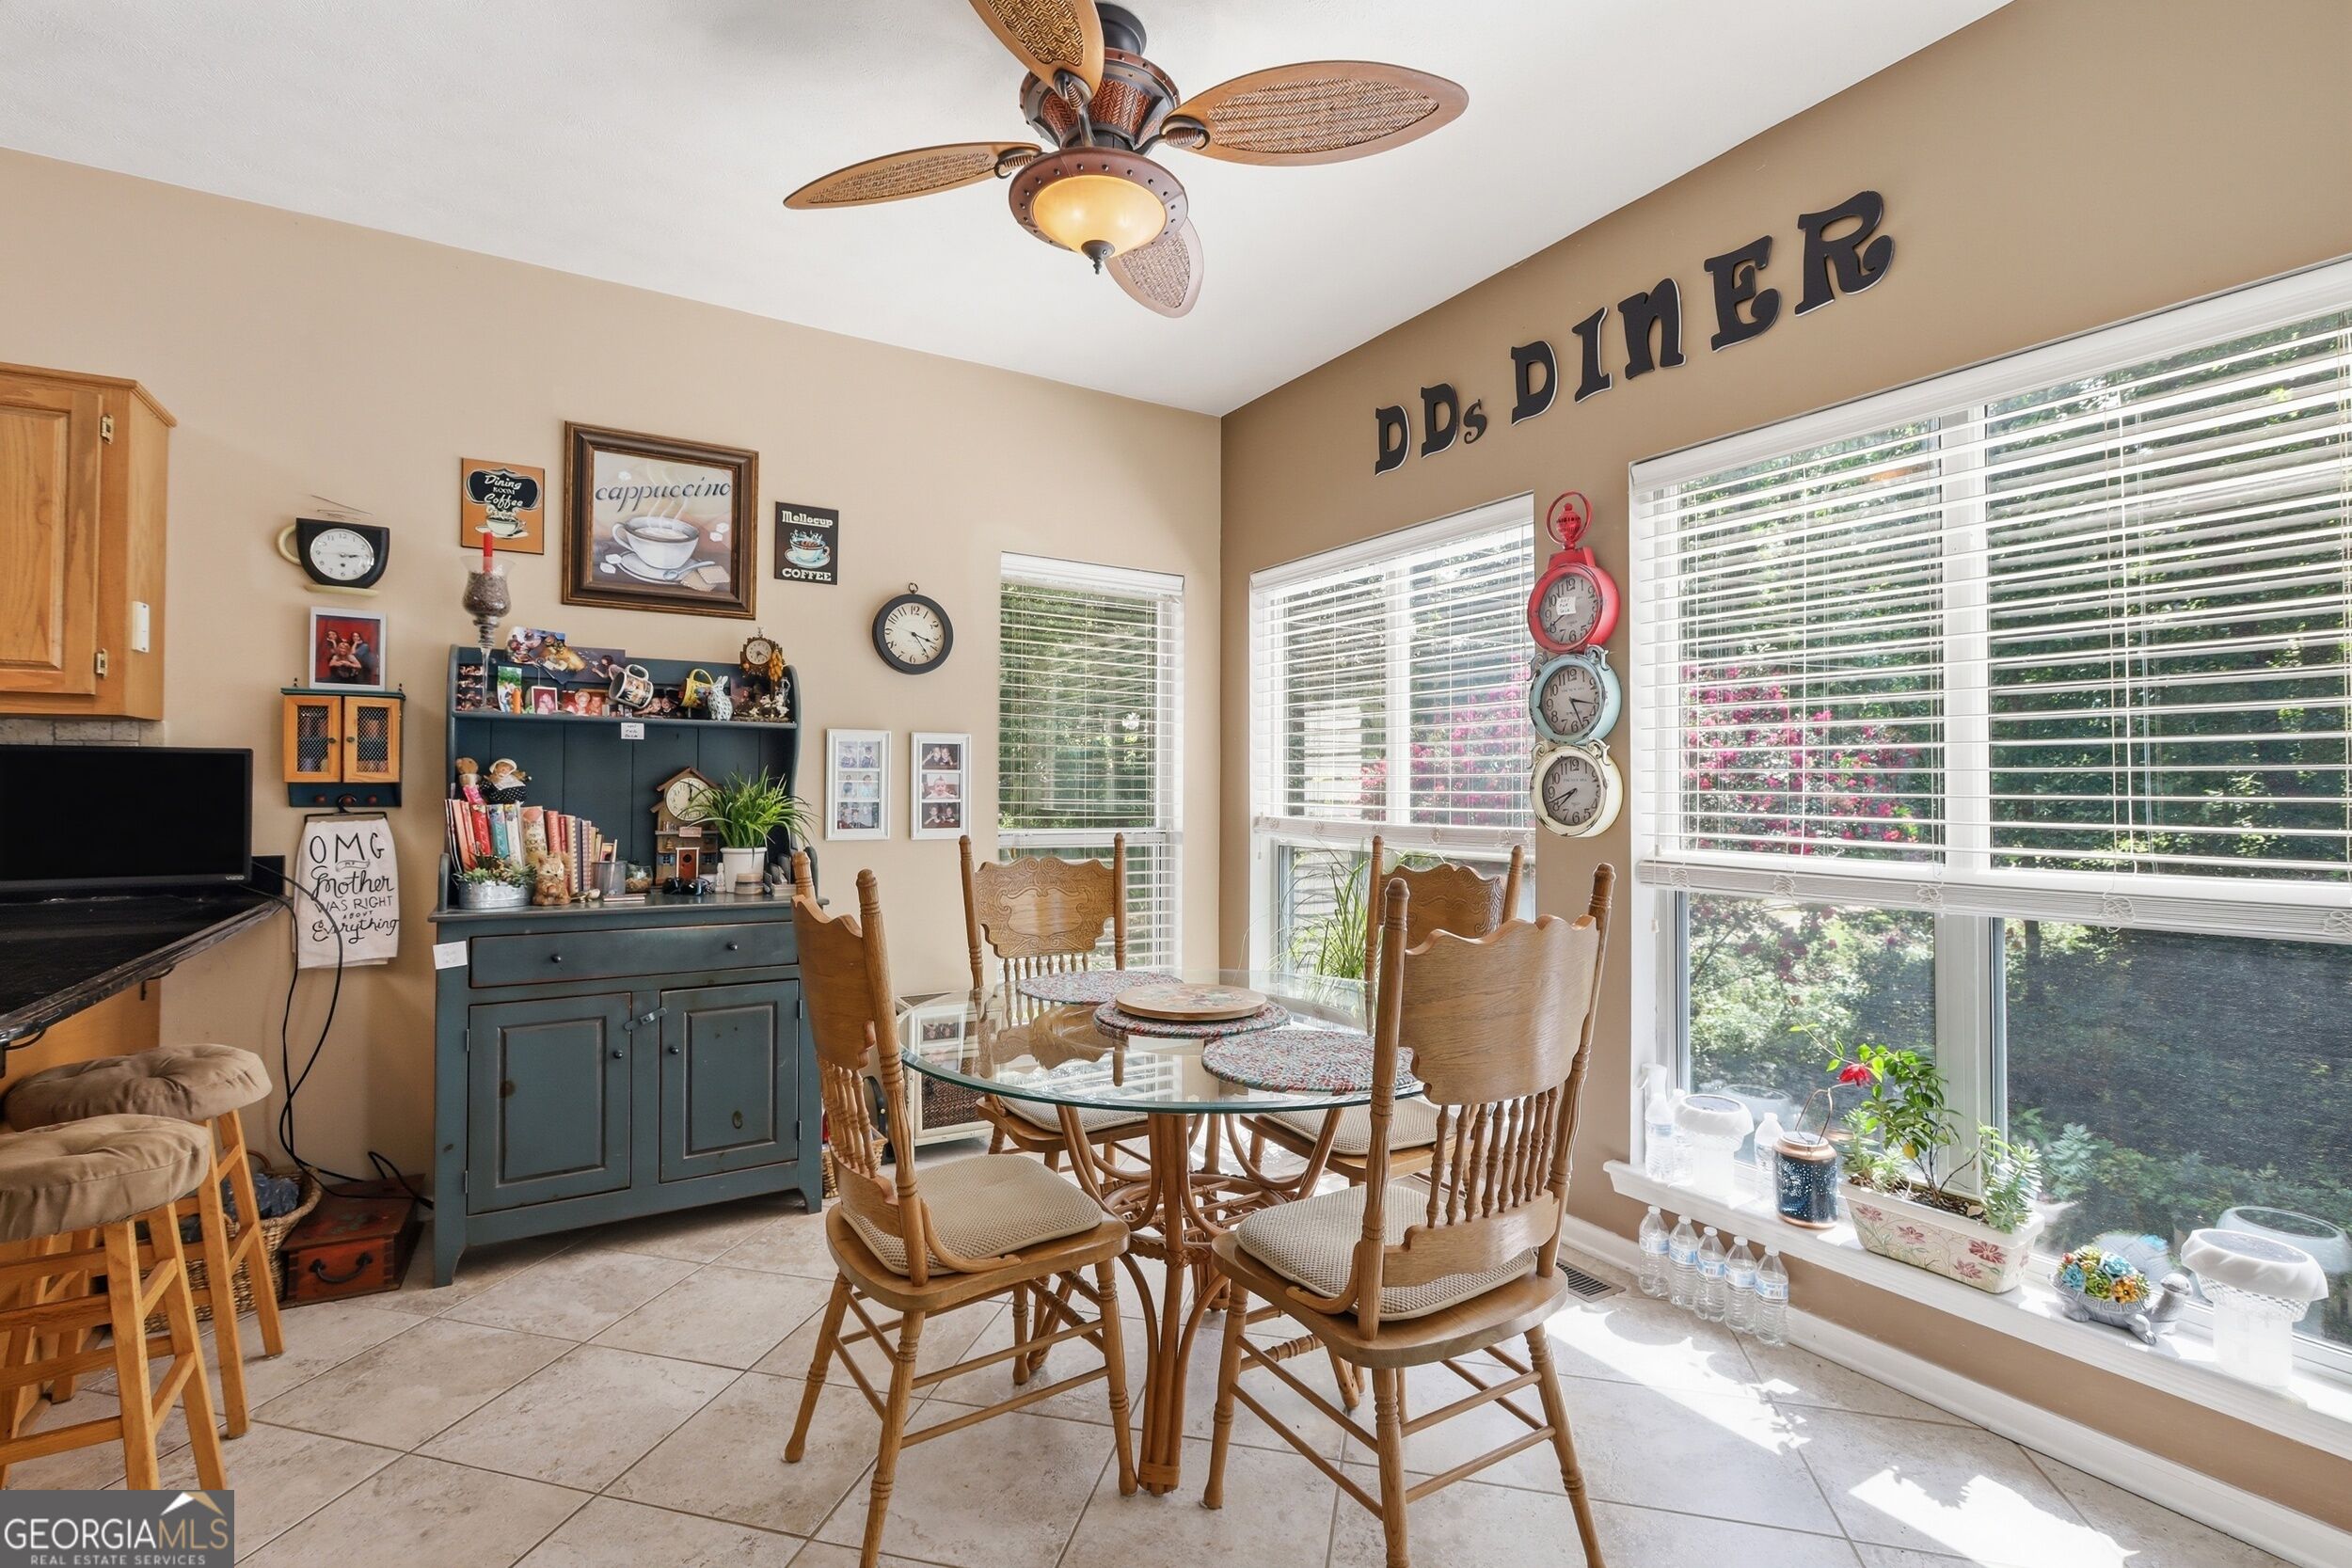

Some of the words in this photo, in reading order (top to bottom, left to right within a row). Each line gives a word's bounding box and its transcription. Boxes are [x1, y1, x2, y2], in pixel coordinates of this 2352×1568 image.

[1375, 382, 1488, 477] DDs
[1510, 190, 1896, 427] DINER
[485, 475, 522, 490] Dining
[484, 493, 524, 509] Coffee
[595, 476, 731, 513] cappuccino
[782, 510, 834, 528] Mellocup
[782, 568, 832, 581] COFFEE
[1566, 578, 1576, 592] 12
[1549, 594, 1557, 608] 10
[898, 607, 907, 617] 11
[911, 606, 920, 616] 12
[1545, 610, 1551, 622] 9
[930, 621, 939, 629] 2
[1560, 629, 1566, 642] 7
[1569, 630, 1577, 642] 6
[910, 655, 916, 663] 6
[1559, 673, 1565, 686] 11
[1567, 669, 1577, 682] 12
[1590, 677, 1597, 690] 2
[1550, 684, 1559, 697] 10
[1547, 699, 1553, 711] 9
[1551, 711, 1558, 723] 8
[1561, 720, 1568, 734] 7
[1571, 721, 1579, 733] 6
[1561, 763, 1567, 775] 11
[1570, 759, 1580, 771] 12
[1552, 772, 1560, 784] 10
[1549, 786, 1555, 799] 9
[1563, 810, 1569, 821] 7
[1572, 812, 1581, 825] 6
[1584, 808, 1592, 819] 5
[310, 832, 385, 863] OMG
[310, 865, 394, 898] Mother
[354, 895, 392, 910] RIGHT
[342, 910, 373, 920] ABOUT
